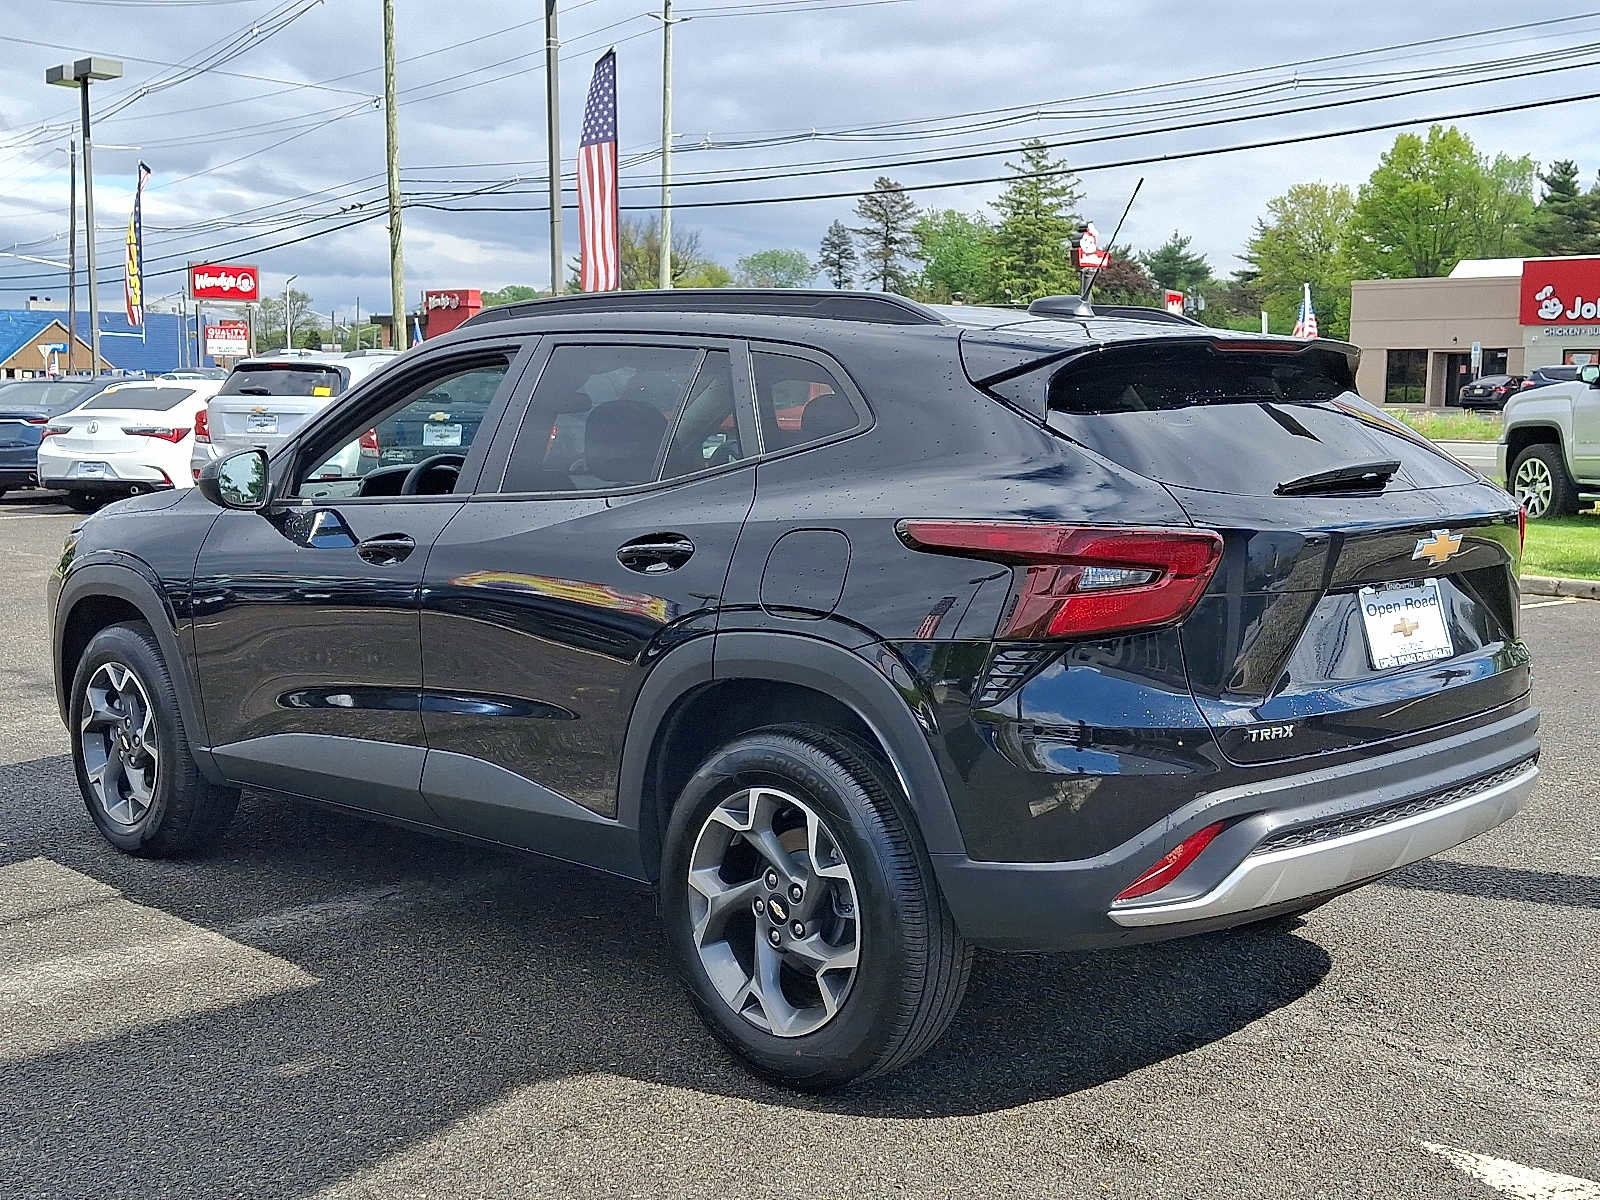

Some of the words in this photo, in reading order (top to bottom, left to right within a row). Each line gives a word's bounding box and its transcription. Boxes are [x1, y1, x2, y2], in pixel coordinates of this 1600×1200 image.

[194, 272, 237, 291] Wendy's
[207, 328, 245, 336] QUALITY
[1544, 327, 1581, 336] CHICKEN
[1366, 602, 1401, 618] Open
[1404, 595, 1437, 610] Road
[1247, 724, 1294, 743] TRAX
